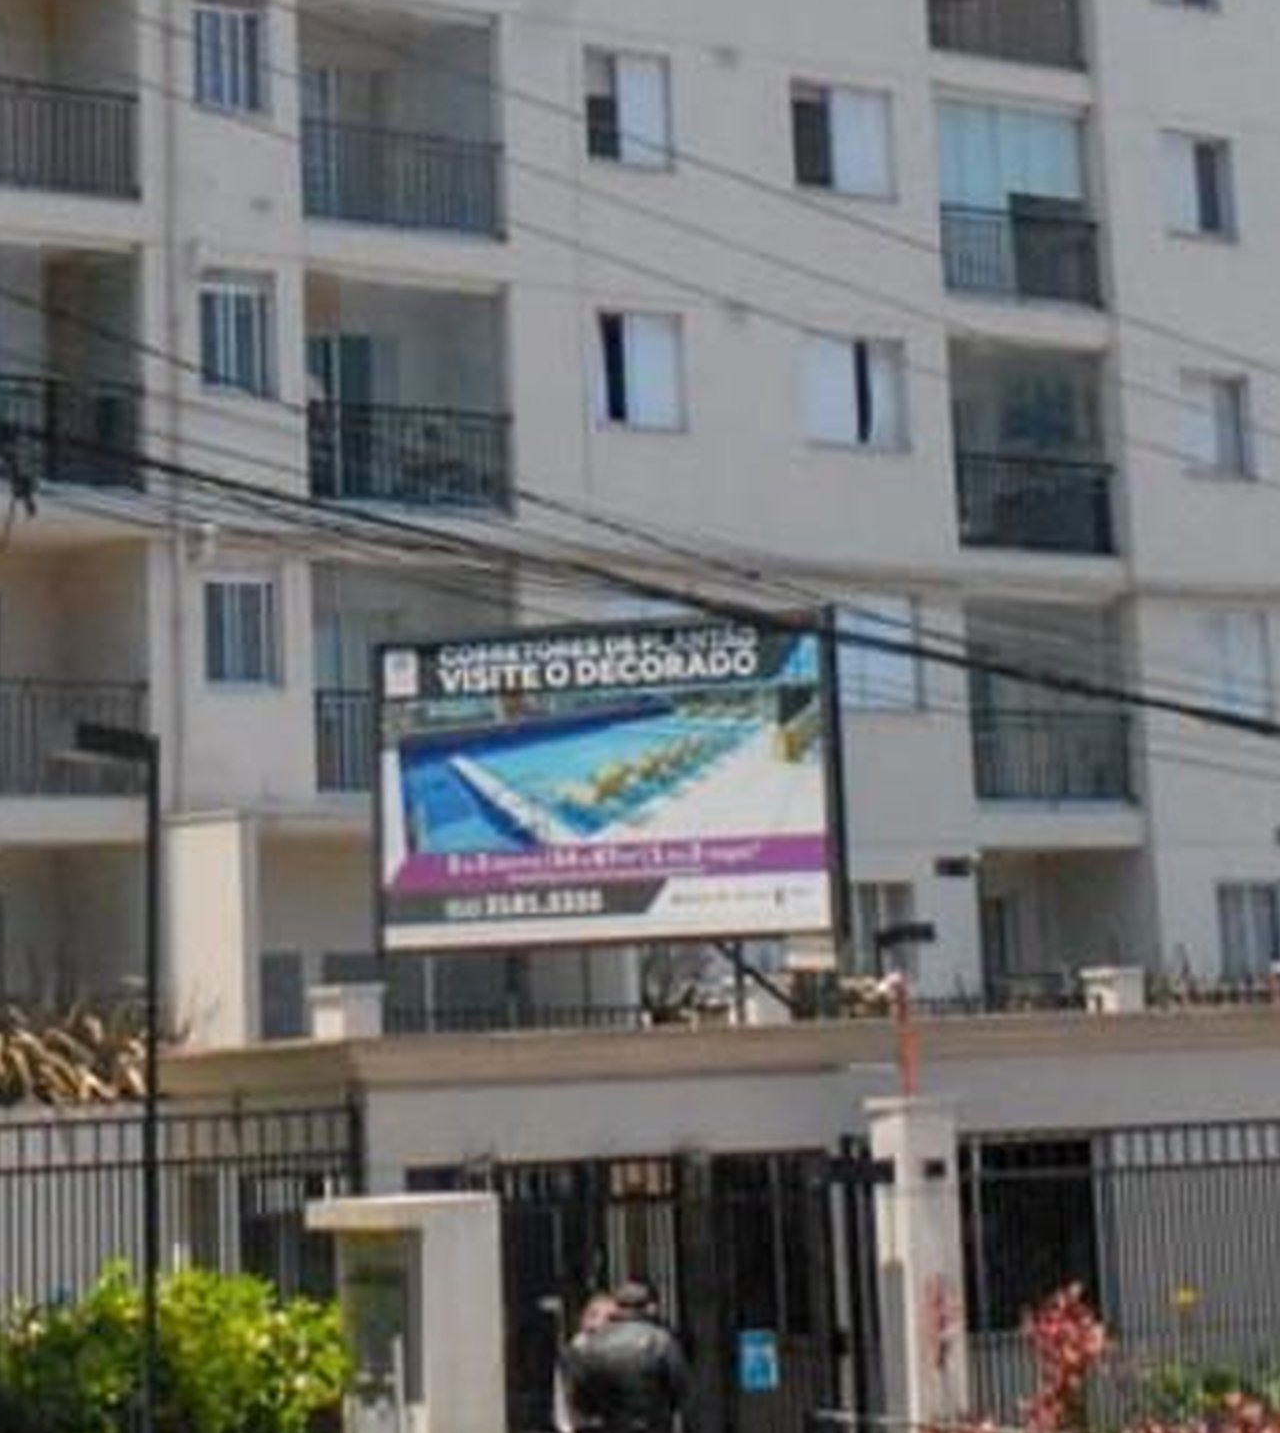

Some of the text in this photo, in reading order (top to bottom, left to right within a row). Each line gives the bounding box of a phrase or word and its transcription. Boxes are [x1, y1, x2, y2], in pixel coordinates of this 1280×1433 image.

[438, 665, 541, 693] VISITE
[544, 660, 570, 688] O
[575, 648, 757, 686] DECORADO
